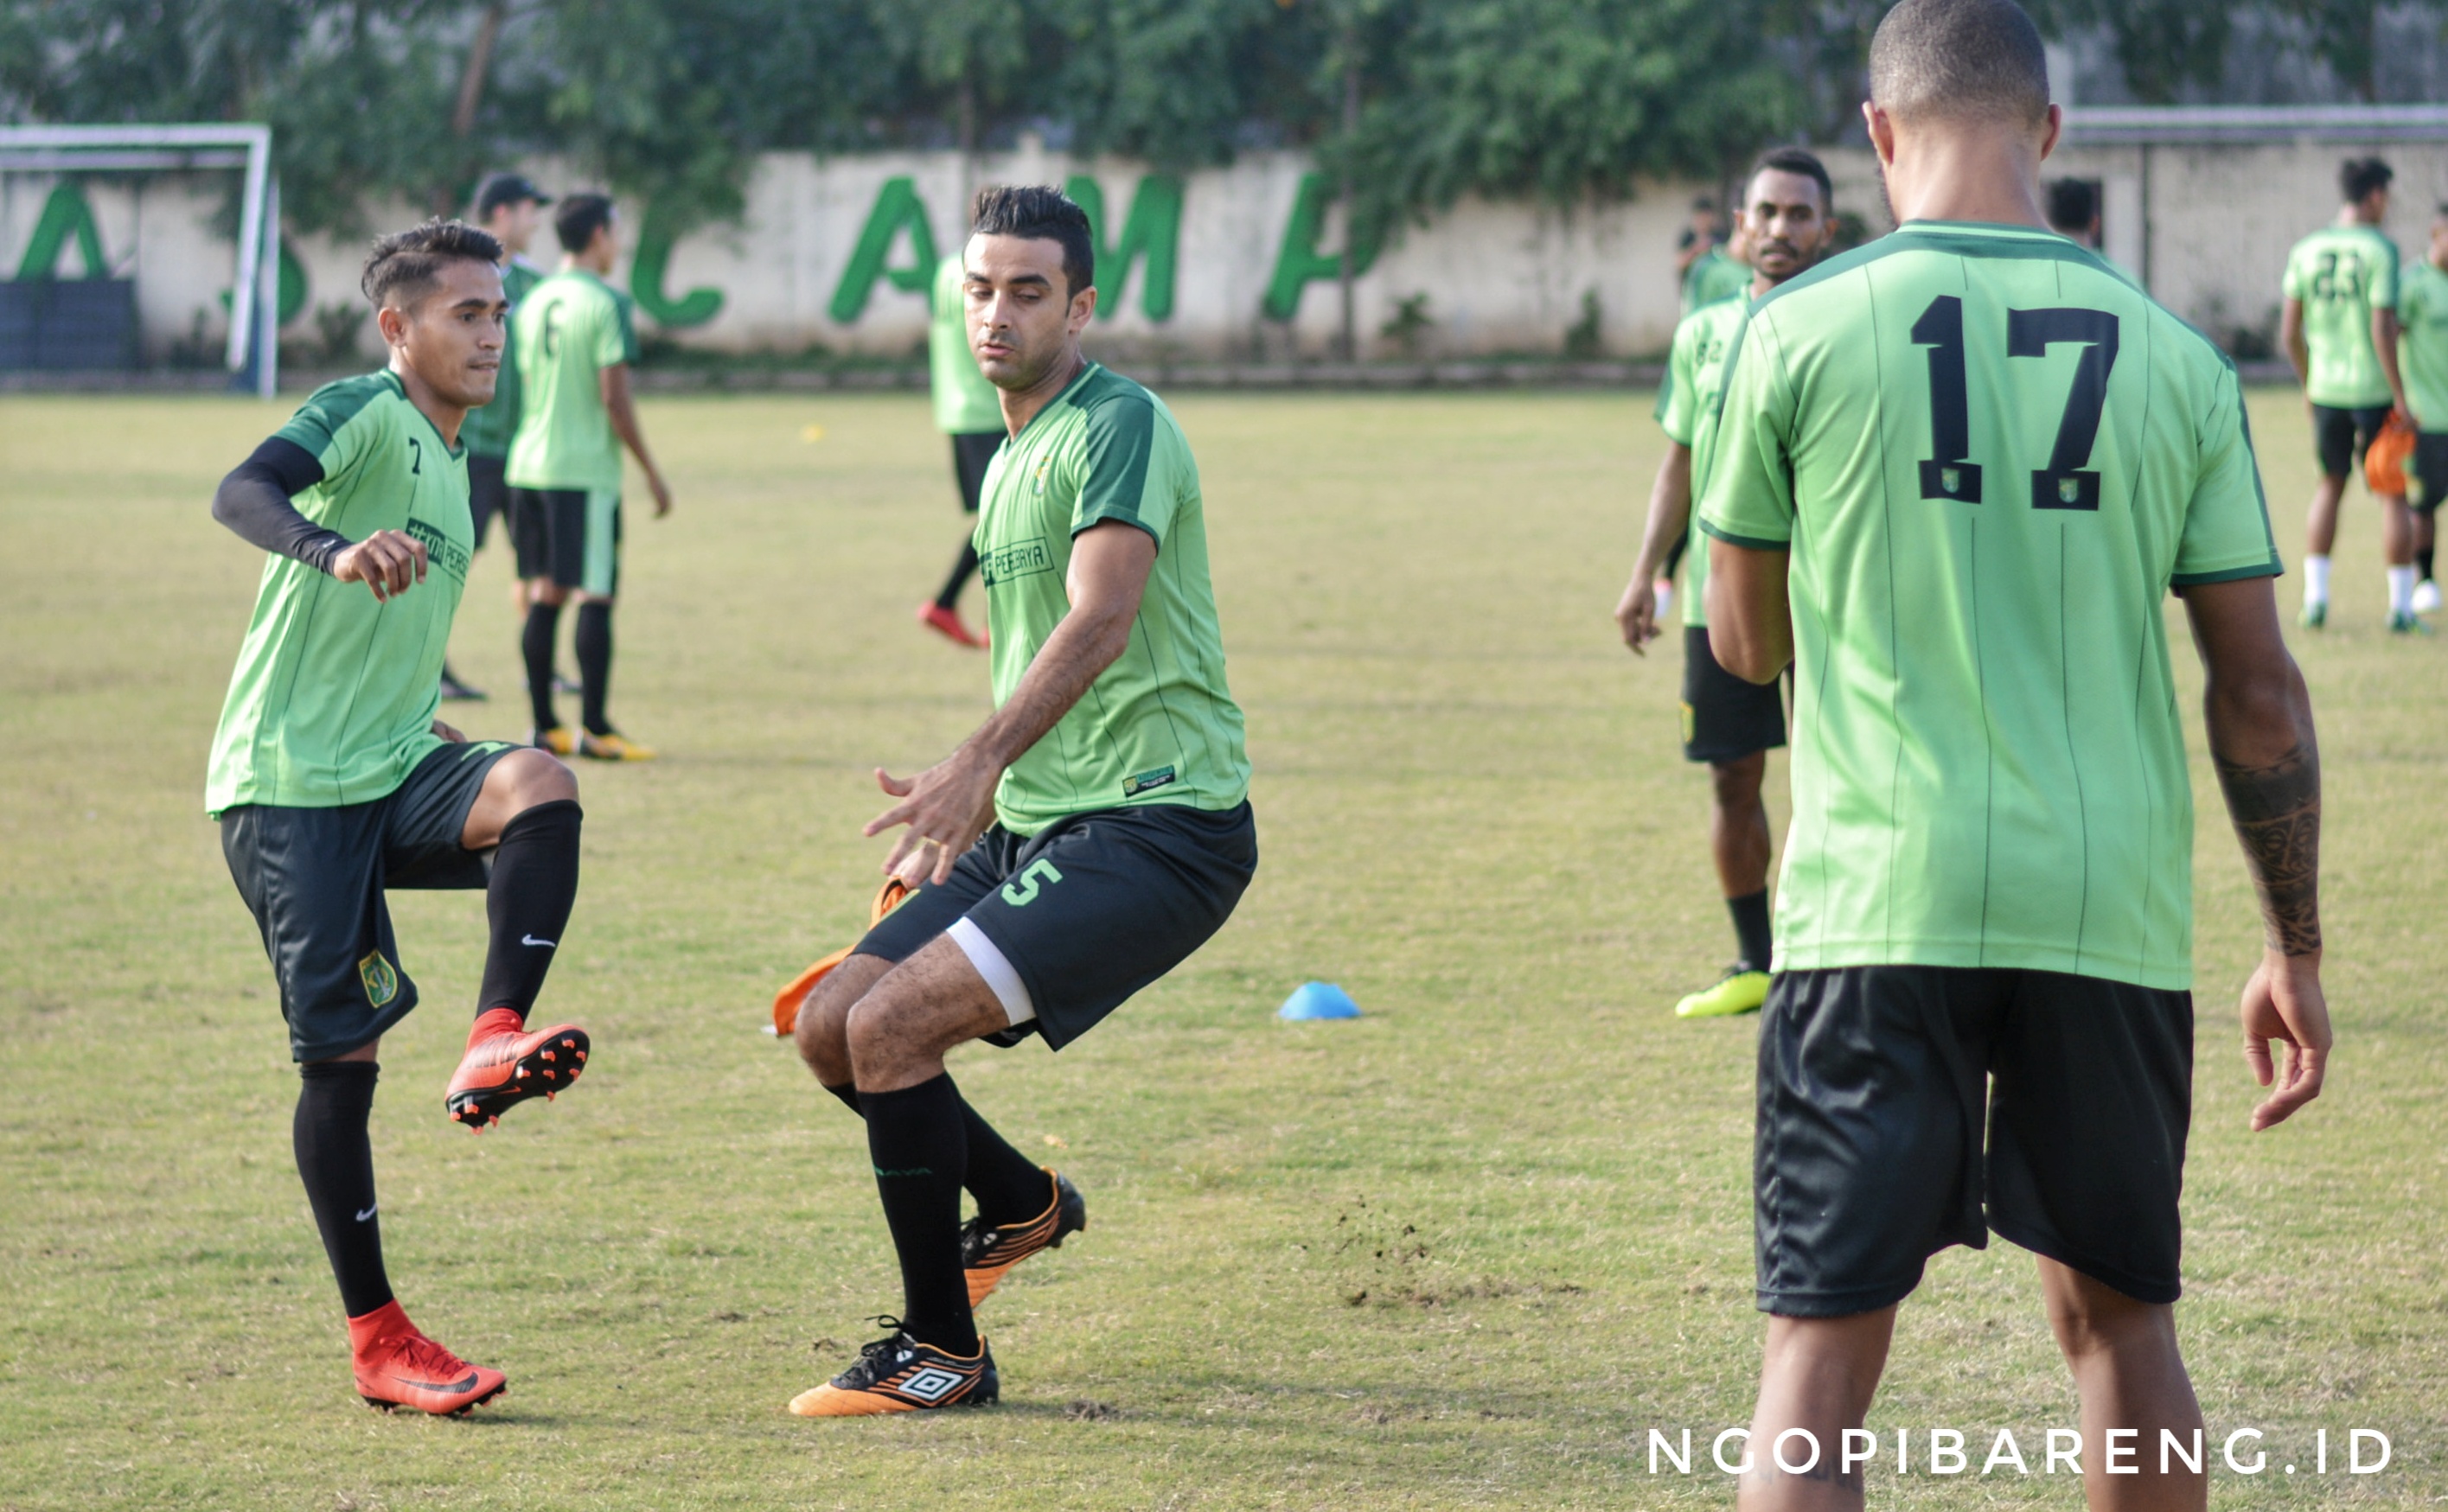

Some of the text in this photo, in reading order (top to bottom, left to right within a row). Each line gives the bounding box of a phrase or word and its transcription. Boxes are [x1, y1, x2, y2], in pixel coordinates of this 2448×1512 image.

[2313, 249, 2362, 301] 23
[1909, 295, 2120, 512] 17
[409, 437, 422, 475] 7
[1000, 858, 1064, 906] 5
